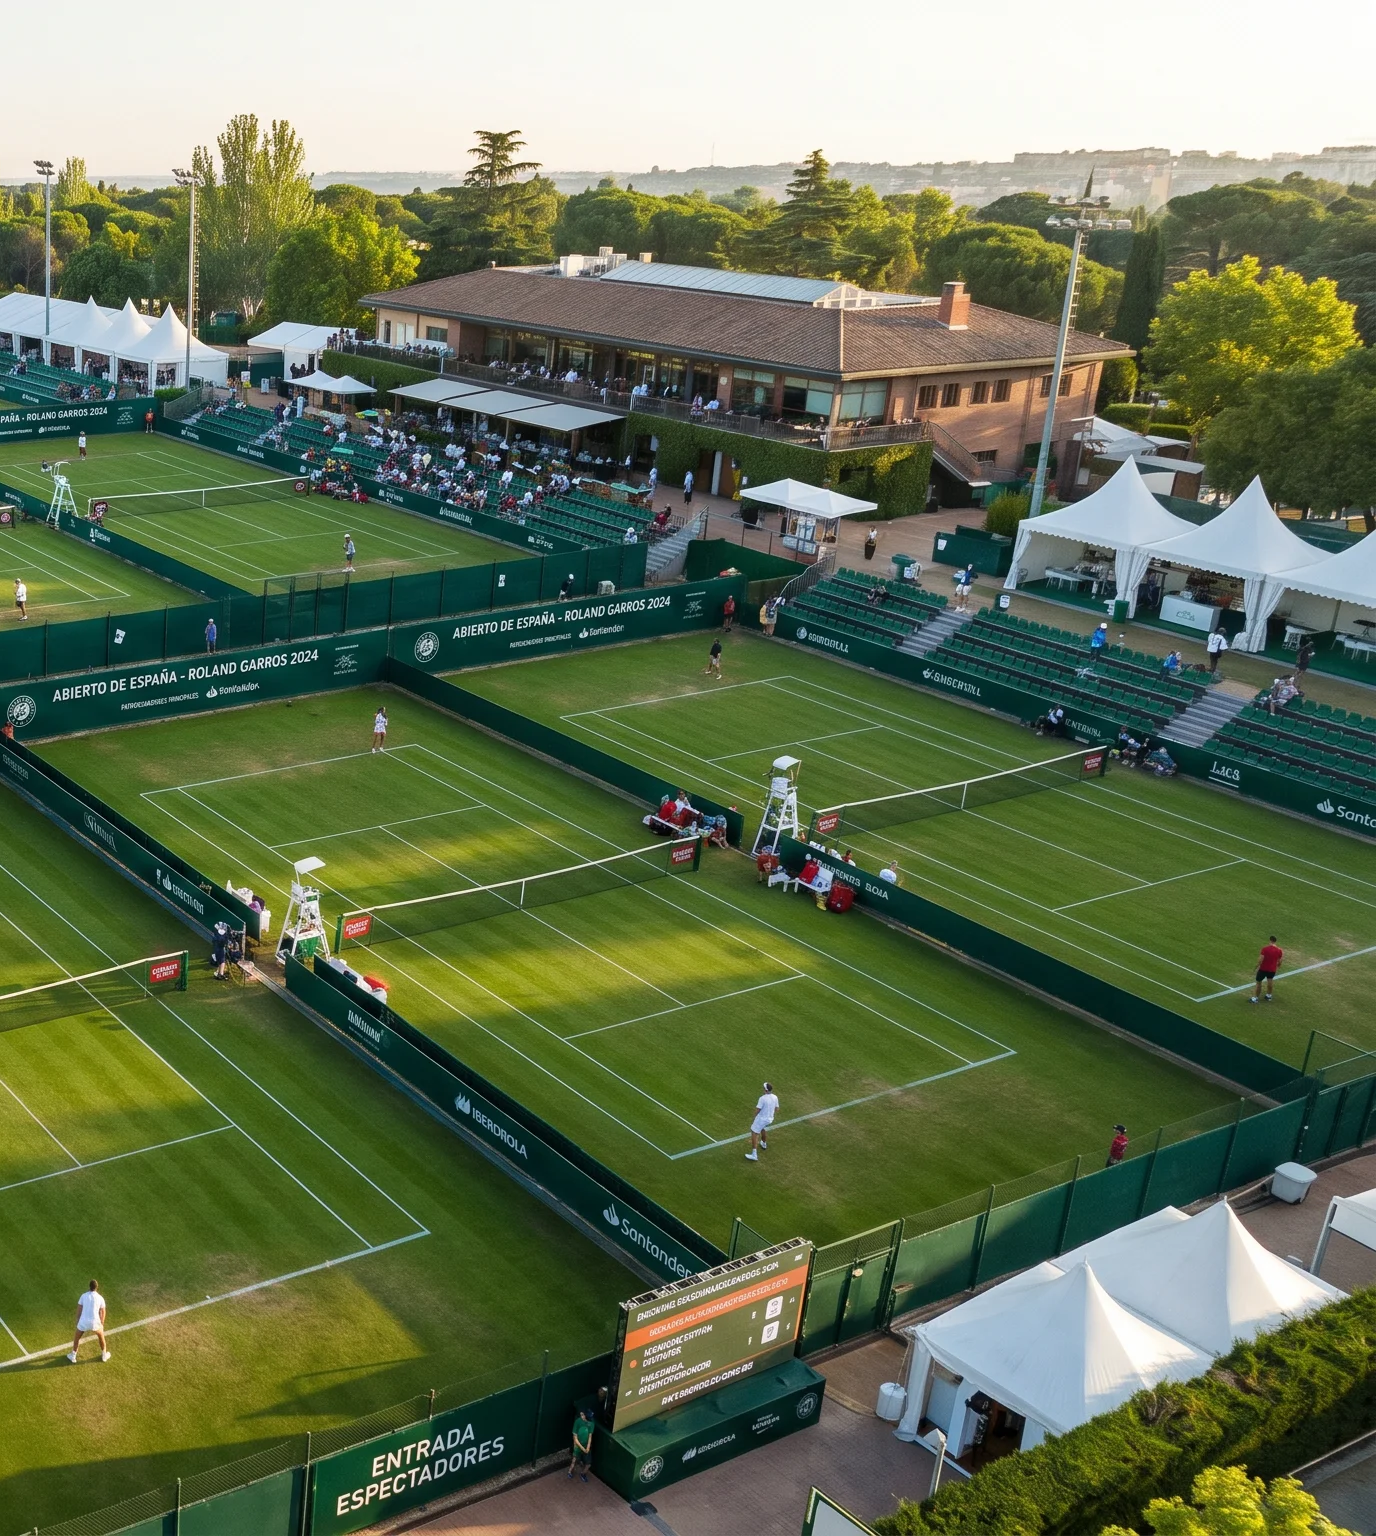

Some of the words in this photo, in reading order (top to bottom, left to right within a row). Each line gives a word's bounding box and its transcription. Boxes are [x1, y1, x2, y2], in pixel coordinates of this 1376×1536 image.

[57, 408, 88, 418] GARROS
[89, 406, 107, 415] 2024
[452, 621, 498, 639] ABIERTO
[500, 619, 514, 631] DE
[516, 611, 555, 629] ESPAÑA
[564, 605, 605, 621] ROLAND
[607, 598, 645, 615] GARROS
[646, 595, 670, 609] 2024
[52, 681, 106, 702] ABIERTO
[110, 678, 126, 692] DE
[130, 668, 177, 689] ESPAÑA
[188, 661, 236, 680] ROLAND
[240, 653, 287, 672] GARROS
[290, 648, 318, 664] 2024
[473, 1107, 528, 1160] IBERDROLA
[621, 1218, 692, 1278] Santander
[336, 1436, 505, 1517] ESPECTADORES
[372, 1423, 475, 1478] ENTRADA
